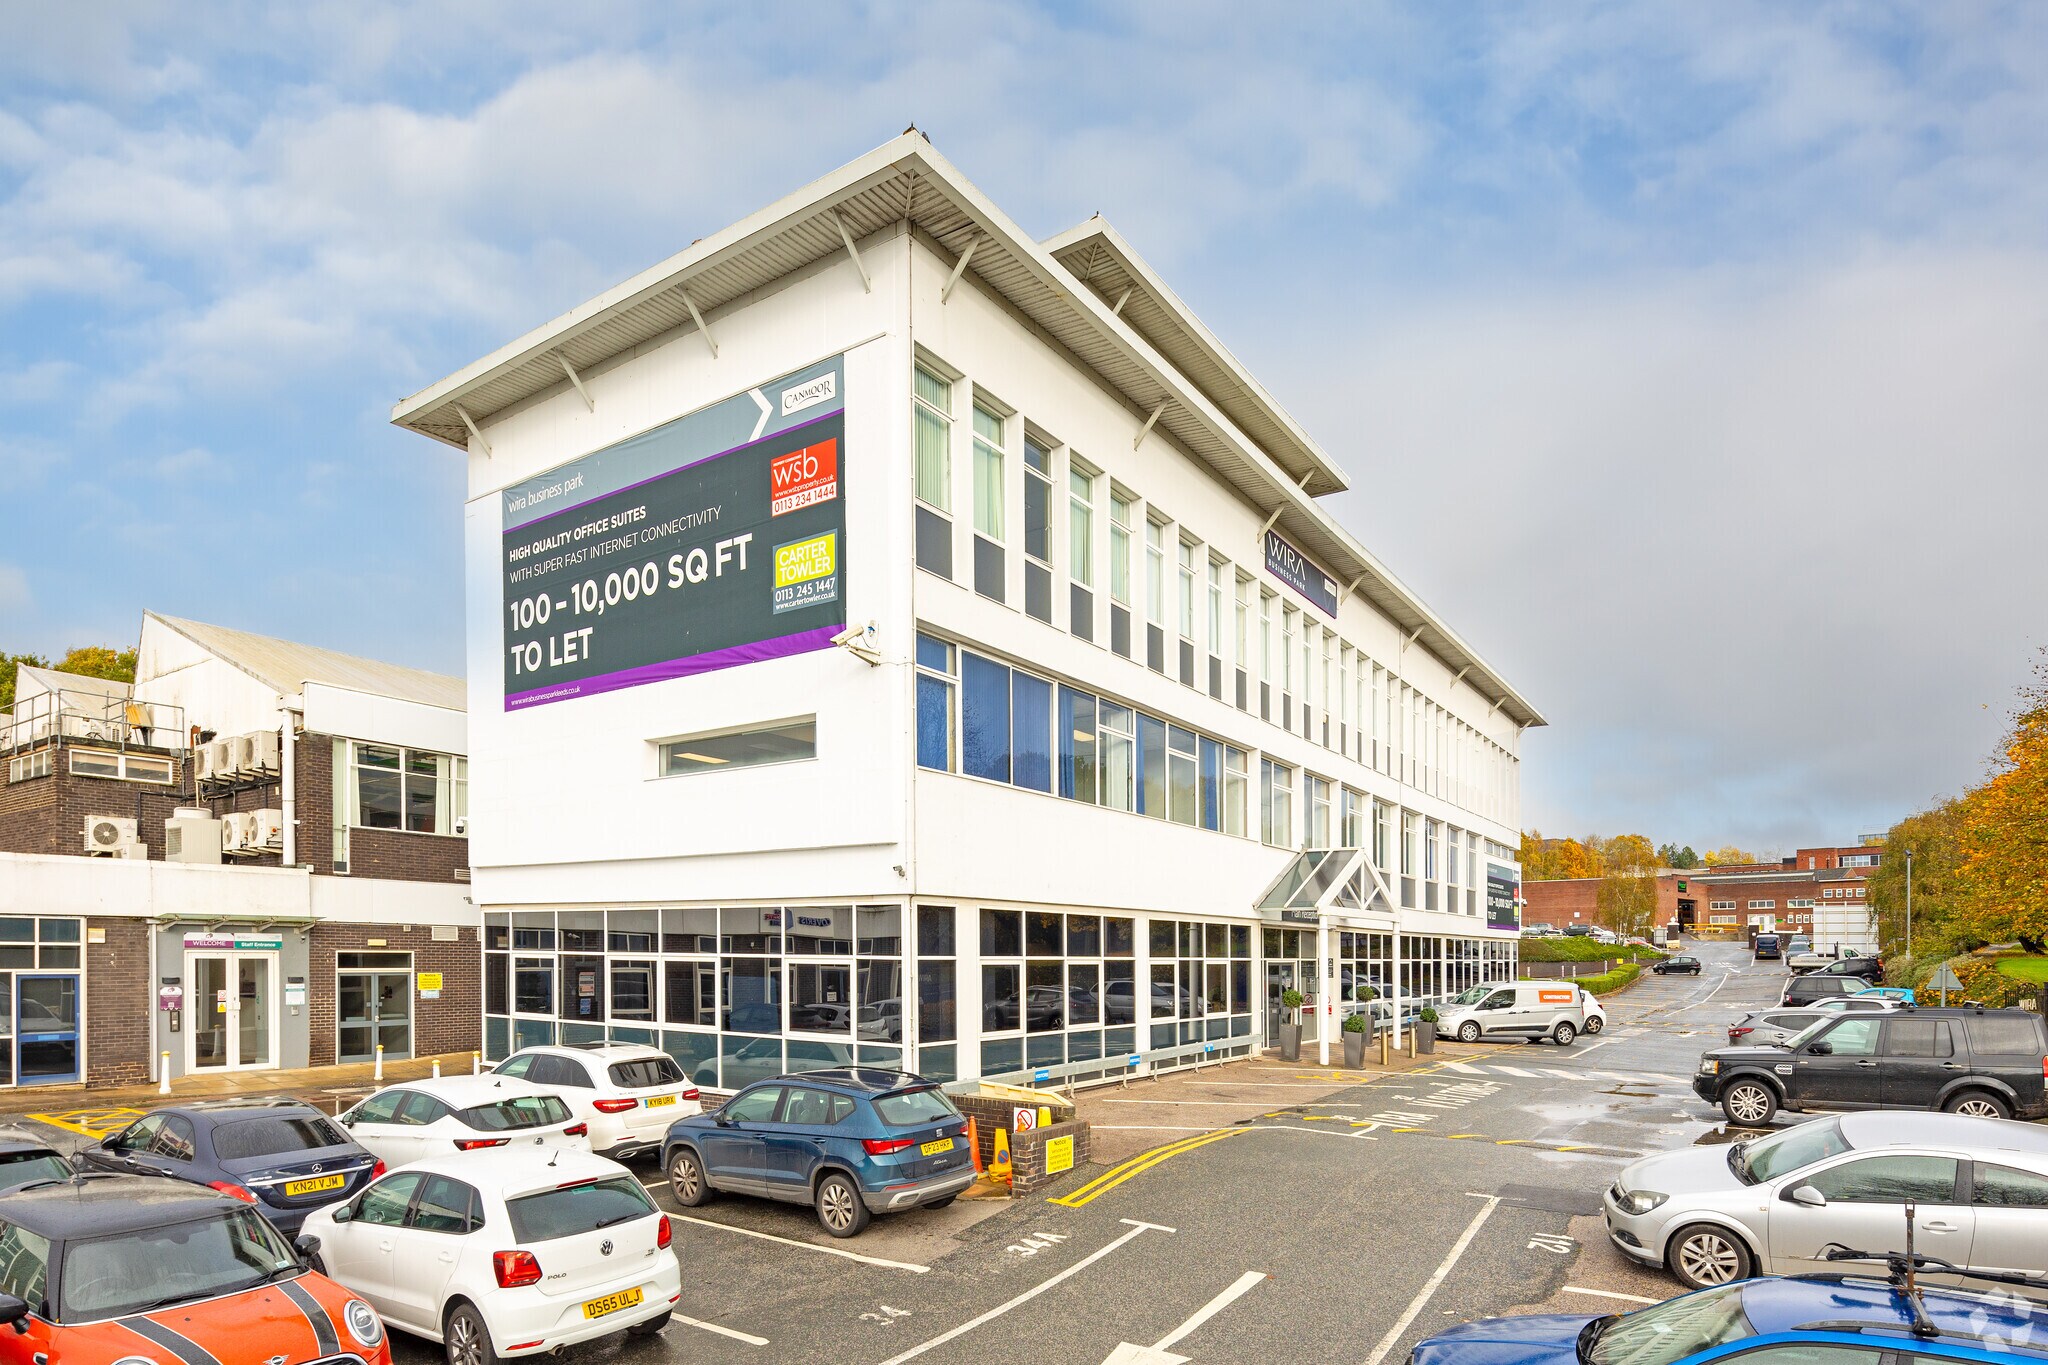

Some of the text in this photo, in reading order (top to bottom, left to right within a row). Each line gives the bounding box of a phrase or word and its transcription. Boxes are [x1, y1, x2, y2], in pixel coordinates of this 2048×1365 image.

[784, 380, 832, 409] CANMOOR
[773, 448, 818, 488] wsb
[508, 472, 584, 513] wira business park
[774, 485, 834, 513] 0113 234 1444
[775, 474, 835, 498] www.wsbproperty.co.uk
[509, 505, 647, 563] HIGH QUALITY OFFICE SUITES
[509, 505, 722, 584] WITH SUPER FAST INTERNET CONNECTIVITY
[779, 540, 827, 566] CARTER
[1268, 532, 1306, 581] WIRA
[510, 593, 551, 631] 100
[571, 562, 659, 616] 10,000
[668, 548, 709, 589] SQ
[715, 532, 753, 577] FT
[780, 556, 831, 582] TOWLER
[1268, 558, 1292, 582] BUSINESS
[1293, 577, 1306, 592] PARK
[775, 577, 836, 602] 0113 245 1447
[776, 589, 836, 610] www.cartertowler.co.uk
[511, 626, 593, 675] TO LET
[293, 1178, 338, 1193] KN21 VJM
[1006, 1232, 1068, 1256] 34A
[547, 1272, 567, 1280] POLO
[588, 1288, 640, 1316] DS65 ULJ
[858, 1305, 912, 1326] 34
